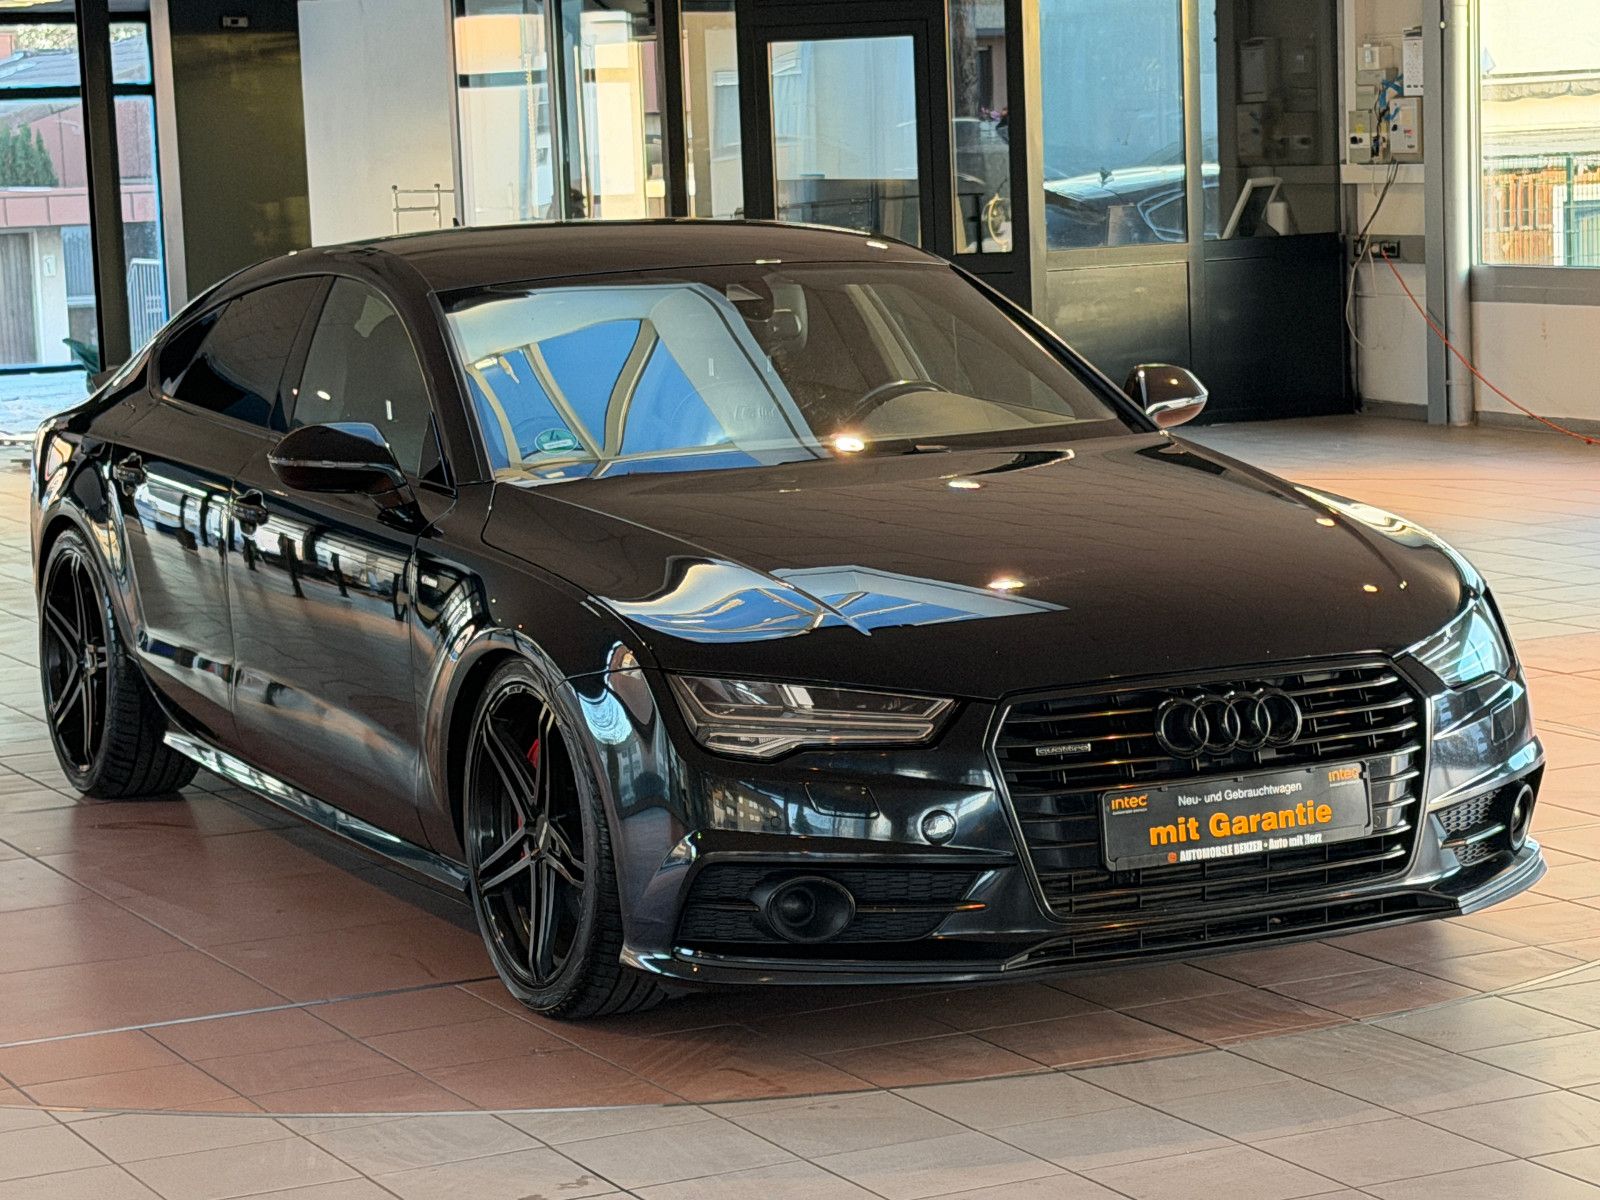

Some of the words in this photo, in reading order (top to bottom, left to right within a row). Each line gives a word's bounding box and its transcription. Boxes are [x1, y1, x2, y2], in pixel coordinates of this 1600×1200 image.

[1111, 795, 1148, 810] intec
[1178, 795, 1202, 807] Neu-
[1204, 791, 1222, 803] und
[1224, 782, 1303, 801] Gebrauchtwagen
[1150, 816, 1200, 846] mit
[1209, 800, 1332, 838] Garantie
